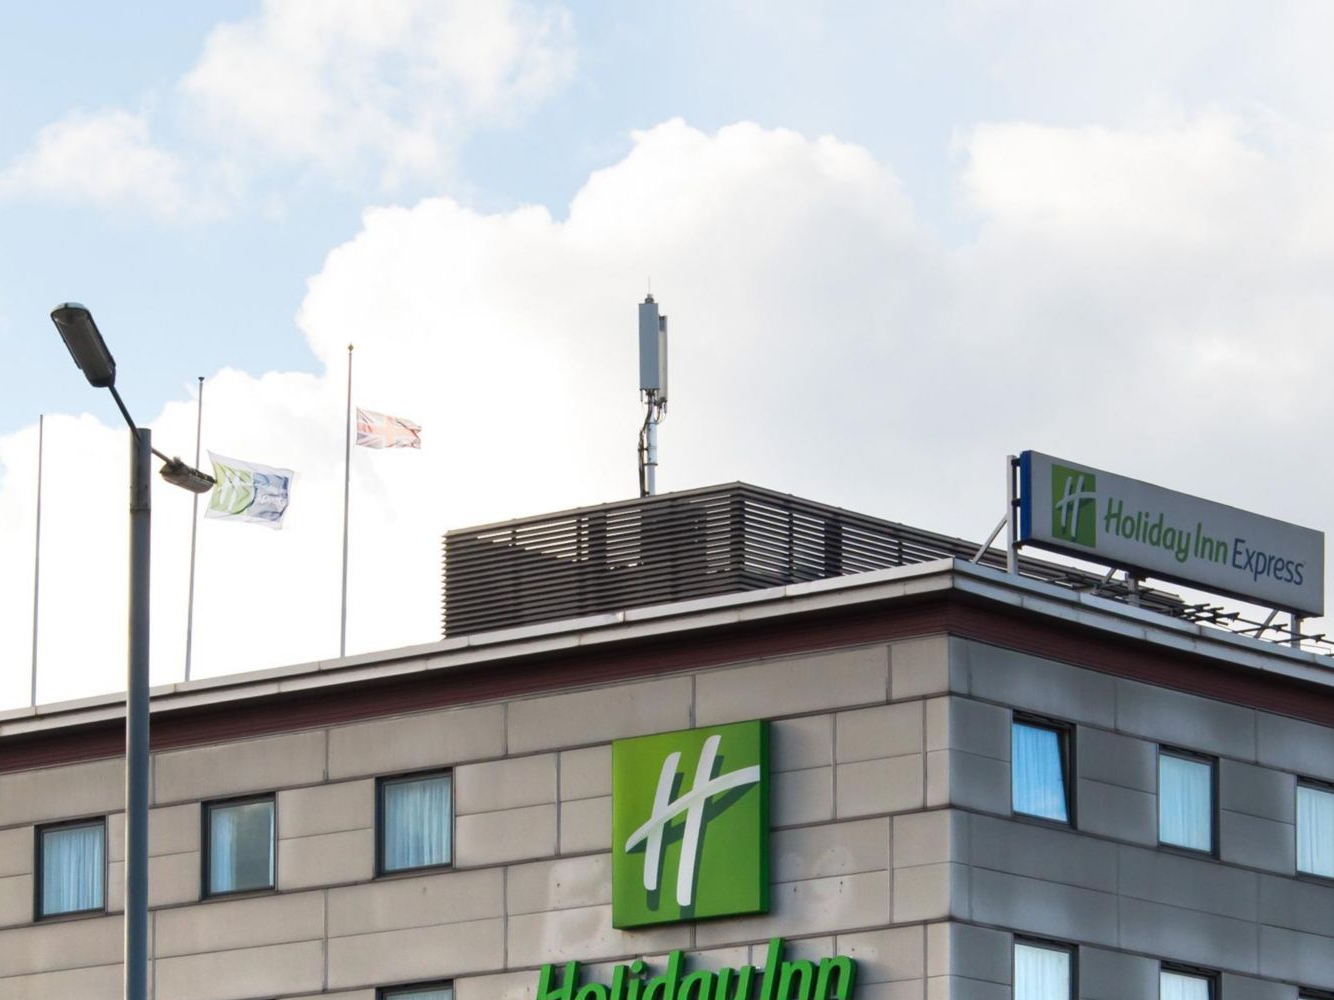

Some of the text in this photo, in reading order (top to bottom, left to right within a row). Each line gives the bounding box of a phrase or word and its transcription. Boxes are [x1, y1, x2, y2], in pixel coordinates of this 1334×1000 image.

[1104, 497, 1304, 586] Holiday Inn Express
